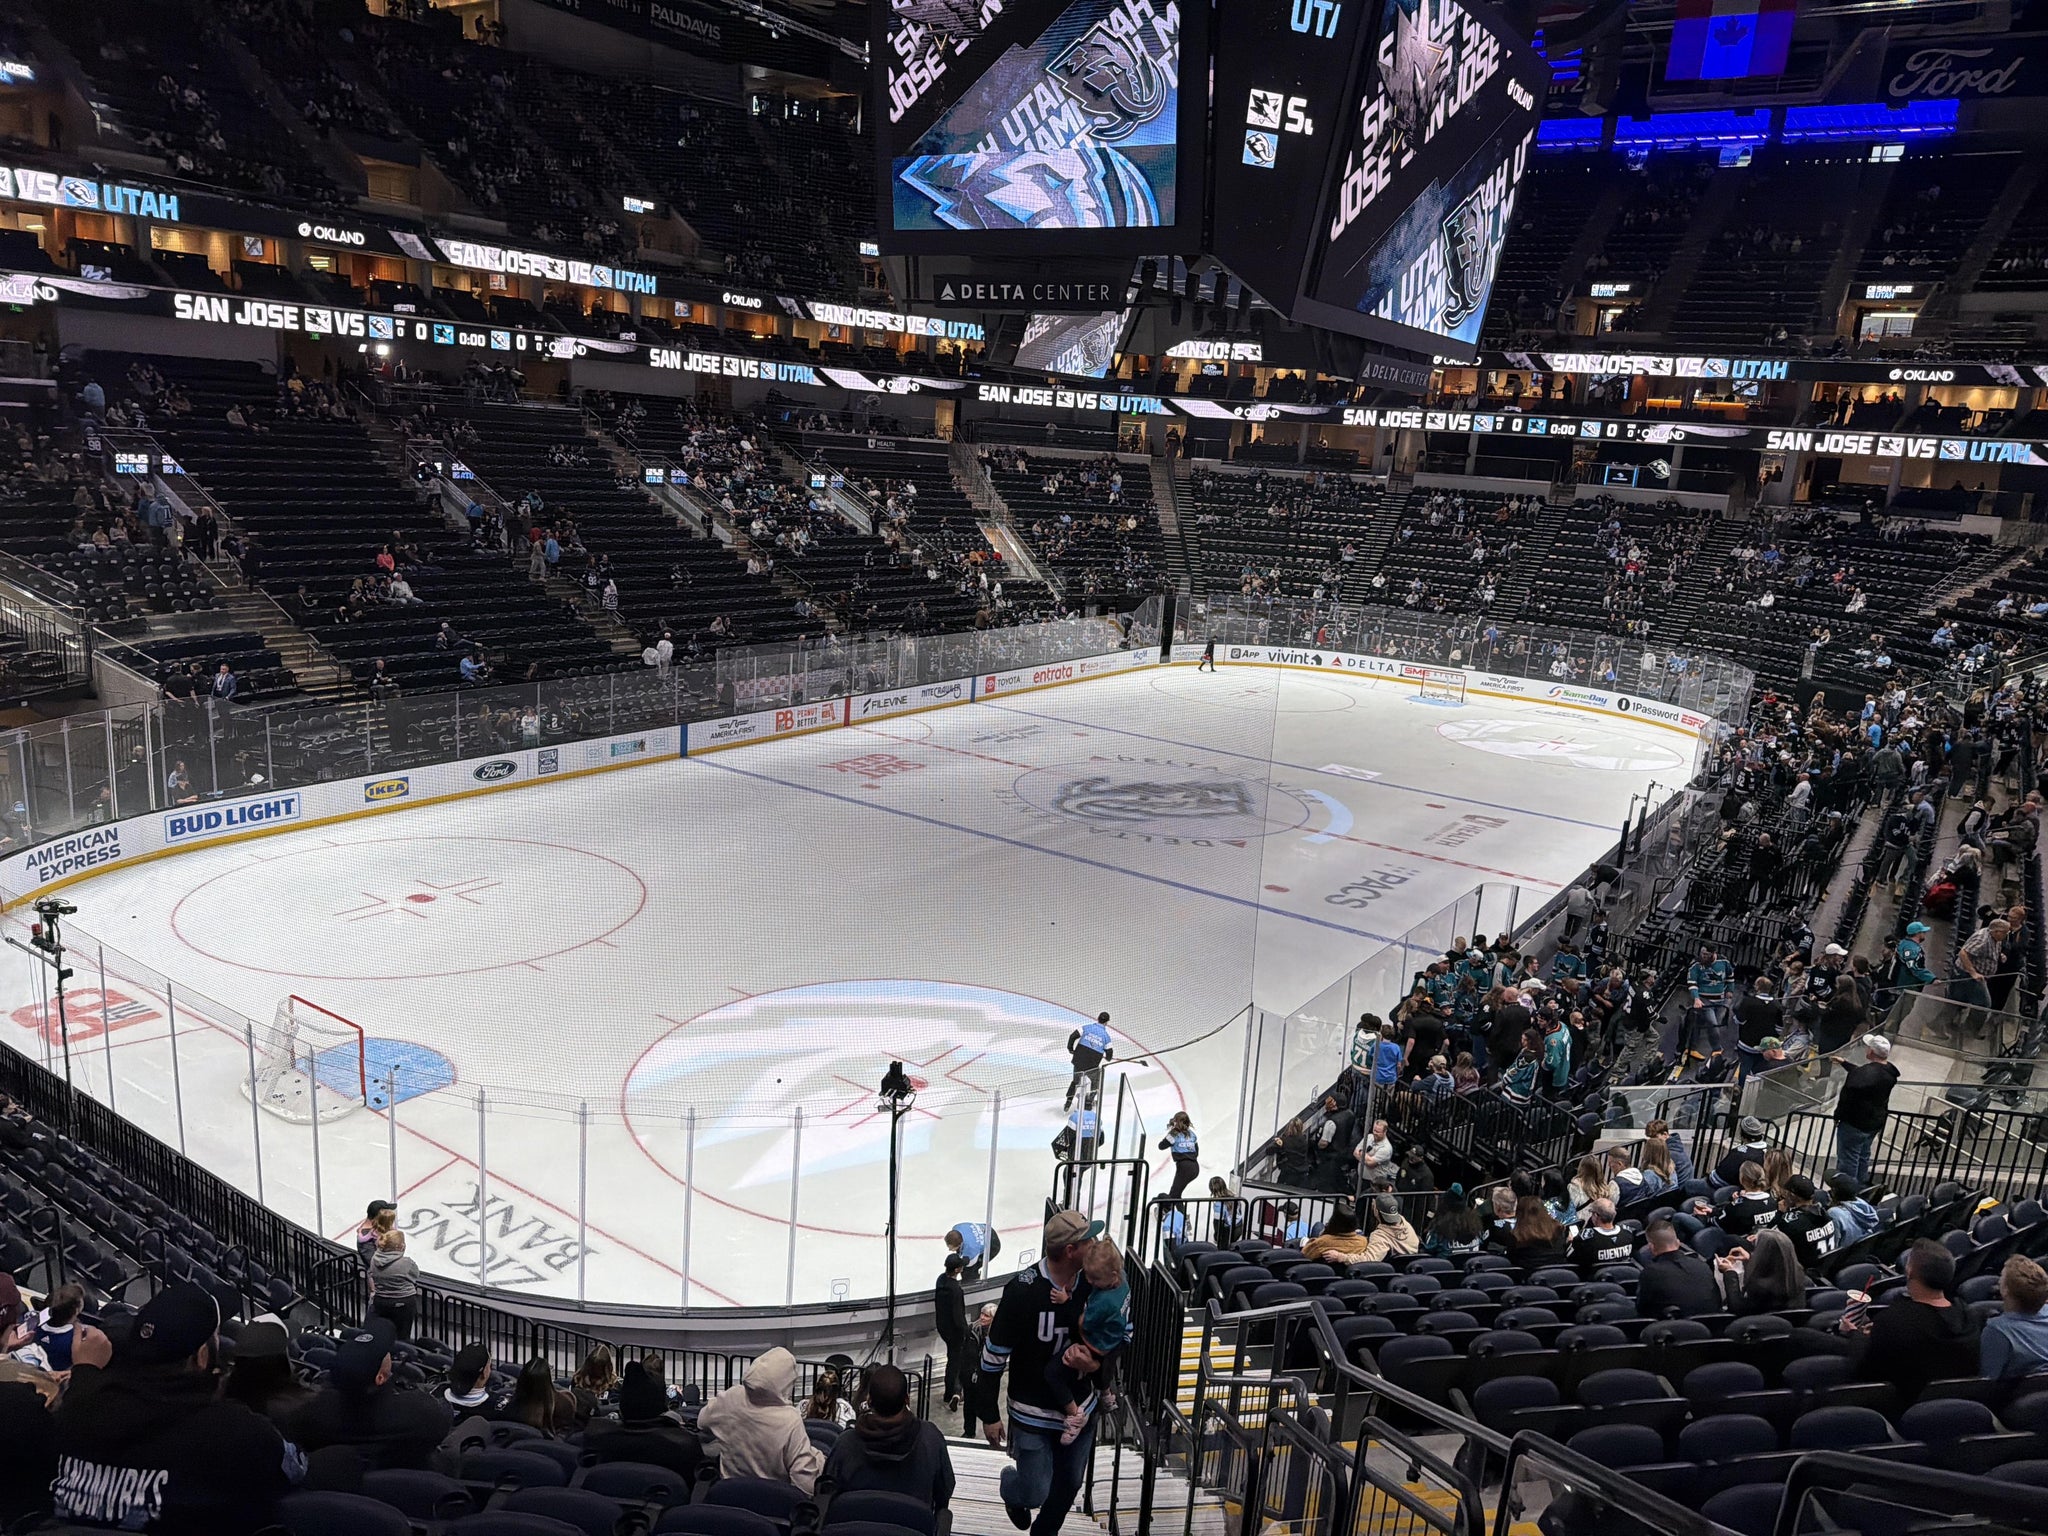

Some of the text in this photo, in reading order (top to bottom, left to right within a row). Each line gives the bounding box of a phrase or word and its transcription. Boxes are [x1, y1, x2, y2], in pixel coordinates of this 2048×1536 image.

[1888, 47, 2025, 98] Ford
[889, 45, 947, 124] JOSE
[14, 168, 179, 221] VS UTAH
[1330, 145, 1391, 242] JOSE
[313, 225, 365, 246] OKLAND
[450, 242, 656, 295] SAN JOSE VS UTAH
[961, 284, 1110, 301] DELTA CENTER
[731, 295, 762, 309] OKLAND
[174, 294, 364, 337] SAN JOSE VS
[815, 303, 845, 324] SAN
[847, 309, 883, 329] JOSE
[416, 323, 427, 340] 0
[459, 332, 485, 347] 0:00
[516, 334, 526, 350] 0
[549, 341, 587, 355] OKLAND
[649, 348, 814, 383] SAN JOSE VS UTAH
[1553, 354, 1788, 379] SAN JOSE VS UTAH
[1371, 364, 1429, 387] DELTA CENTER
[1904, 369, 1954, 381] OKLAND
[978, 385, 1161, 413] SAN JOSE VS UTAH
[1244, 409, 1280, 419] OKLAND
[1342, 409, 1470, 431] SAN JOSE VS
[1512, 418, 1522, 432] 0
[1550, 424, 1576, 435] 0:00
[1607, 423, 1617, 437] 0
[1641, 429, 1685, 440] OKLAND
[1766, 431, 2031, 463] SAN JOSE VS UTAH
[1242, 650, 1260, 659] App
[1348, 658, 1394, 672] DELTA
[997, 676, 1021, 686] TOYOTA
[1033, 665, 1072, 683] entrata
[1480, 681, 1506, 690] AMERICA
[1507, 684, 1524, 692] FIRST
[871, 696, 908, 709] FILEVINE
[1632, 702, 1679, 721] 1Password
[797, 717, 818, 727] BETTER
[710, 726, 756, 740] AMERICA FIRST
[480, 764, 511, 779] Ford
[369, 782, 407, 797] IKEA
[170, 798, 296, 837] BUD LIGHT
[26, 827, 119, 870] AMERICAN
[39, 844, 121, 883] EXPRESS
[1325, 869, 1411, 909] PACS
[442, 1183, 600, 1274] BANK
